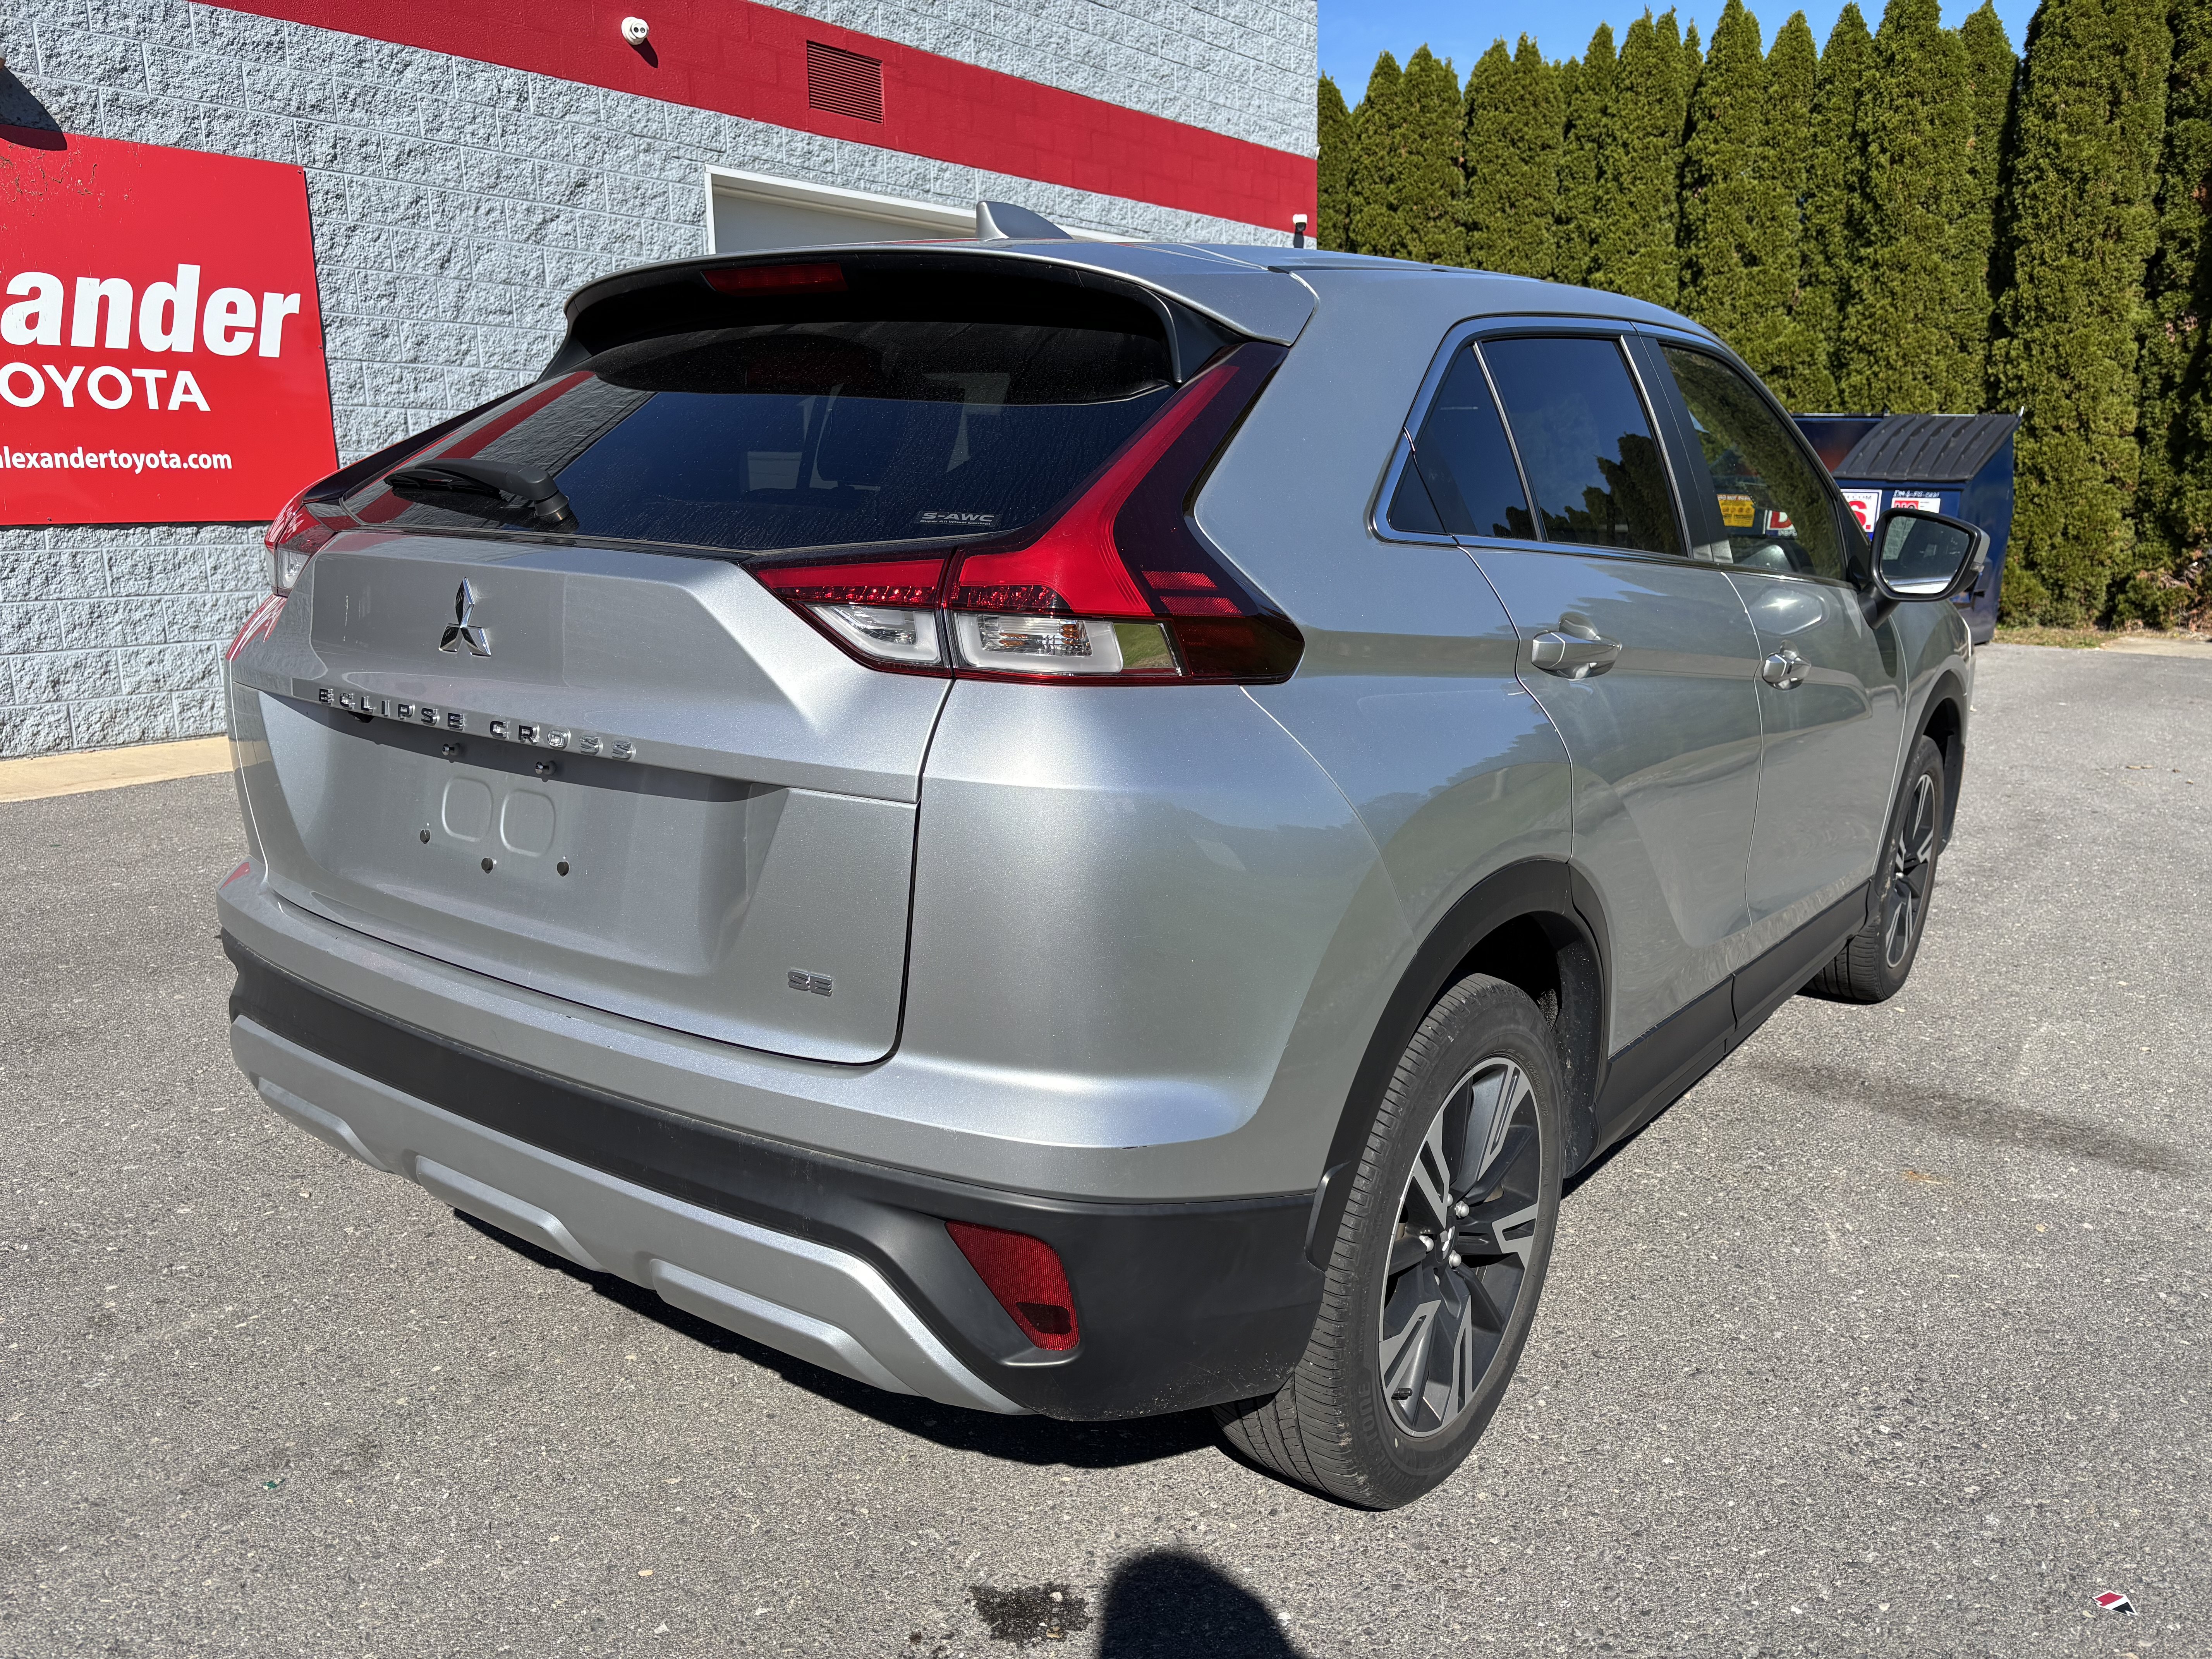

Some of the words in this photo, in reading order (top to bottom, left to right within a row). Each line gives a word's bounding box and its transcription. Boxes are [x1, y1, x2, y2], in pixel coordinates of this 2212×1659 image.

[0, 446, 232, 474] lexandertoyota.com
[922, 512, 994, 522] S-AWC
[319, 688, 467, 731] ECLIPSE
[490, 720, 636, 761] CROSS
[787, 969, 833, 997] SE
